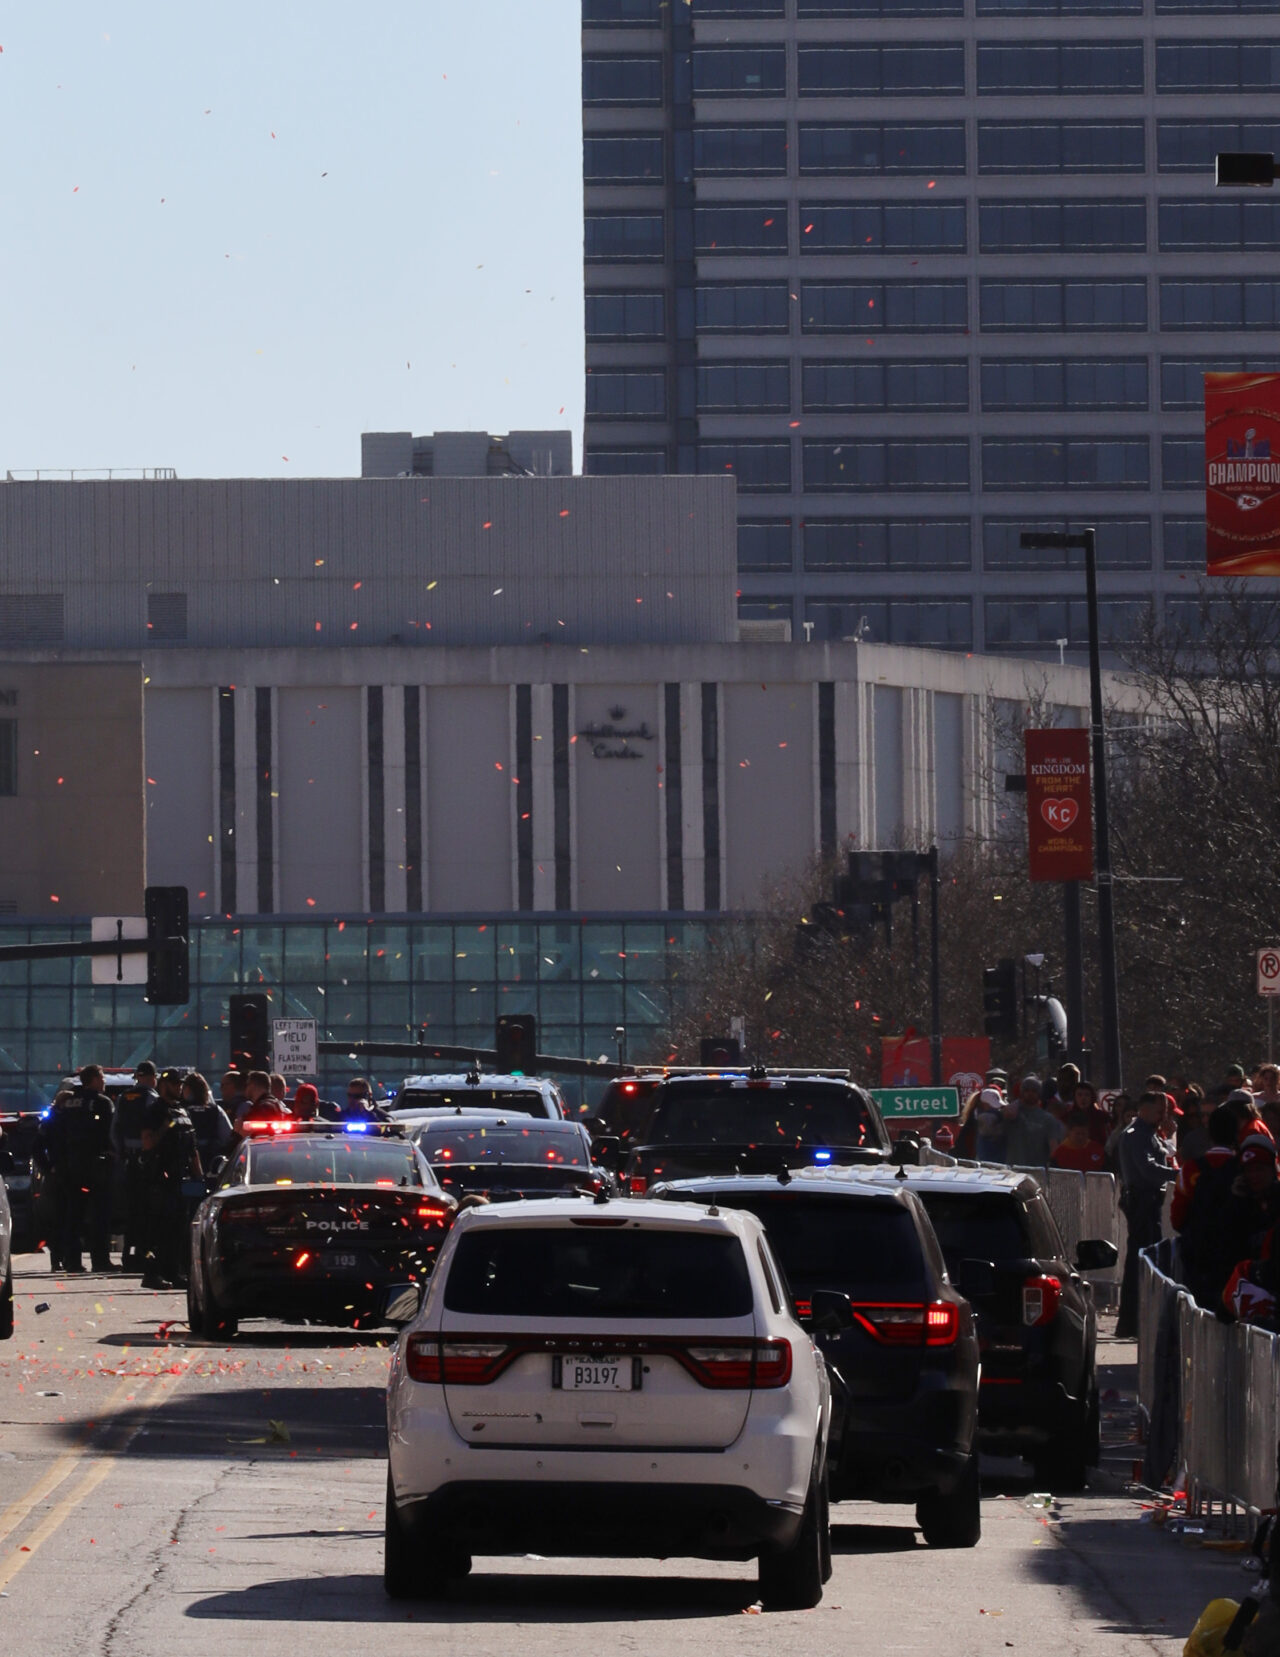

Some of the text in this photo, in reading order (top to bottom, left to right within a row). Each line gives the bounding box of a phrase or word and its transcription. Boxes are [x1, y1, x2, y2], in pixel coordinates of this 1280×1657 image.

[1209, 463, 1280, 486] CHAMPION
[579, 721, 657, 746] Hallmark
[593, 743, 644, 759] Cards
[1031, 764, 1085, 775] KINGDOM
[1036, 776, 1081, 785] FROM THE
[1043, 785, 1073, 793] HEART
[1048, 806, 1070, 823] KC
[275, 1021, 291, 1030] LEFT
[283, 1032, 307, 1043] YIELD
[278, 1054, 312, 1062] FLASHING
[894, 1096, 948, 1111] Street
[306, 1221, 370, 1231] POLICE
[575, 1367, 618, 1384] B3197
